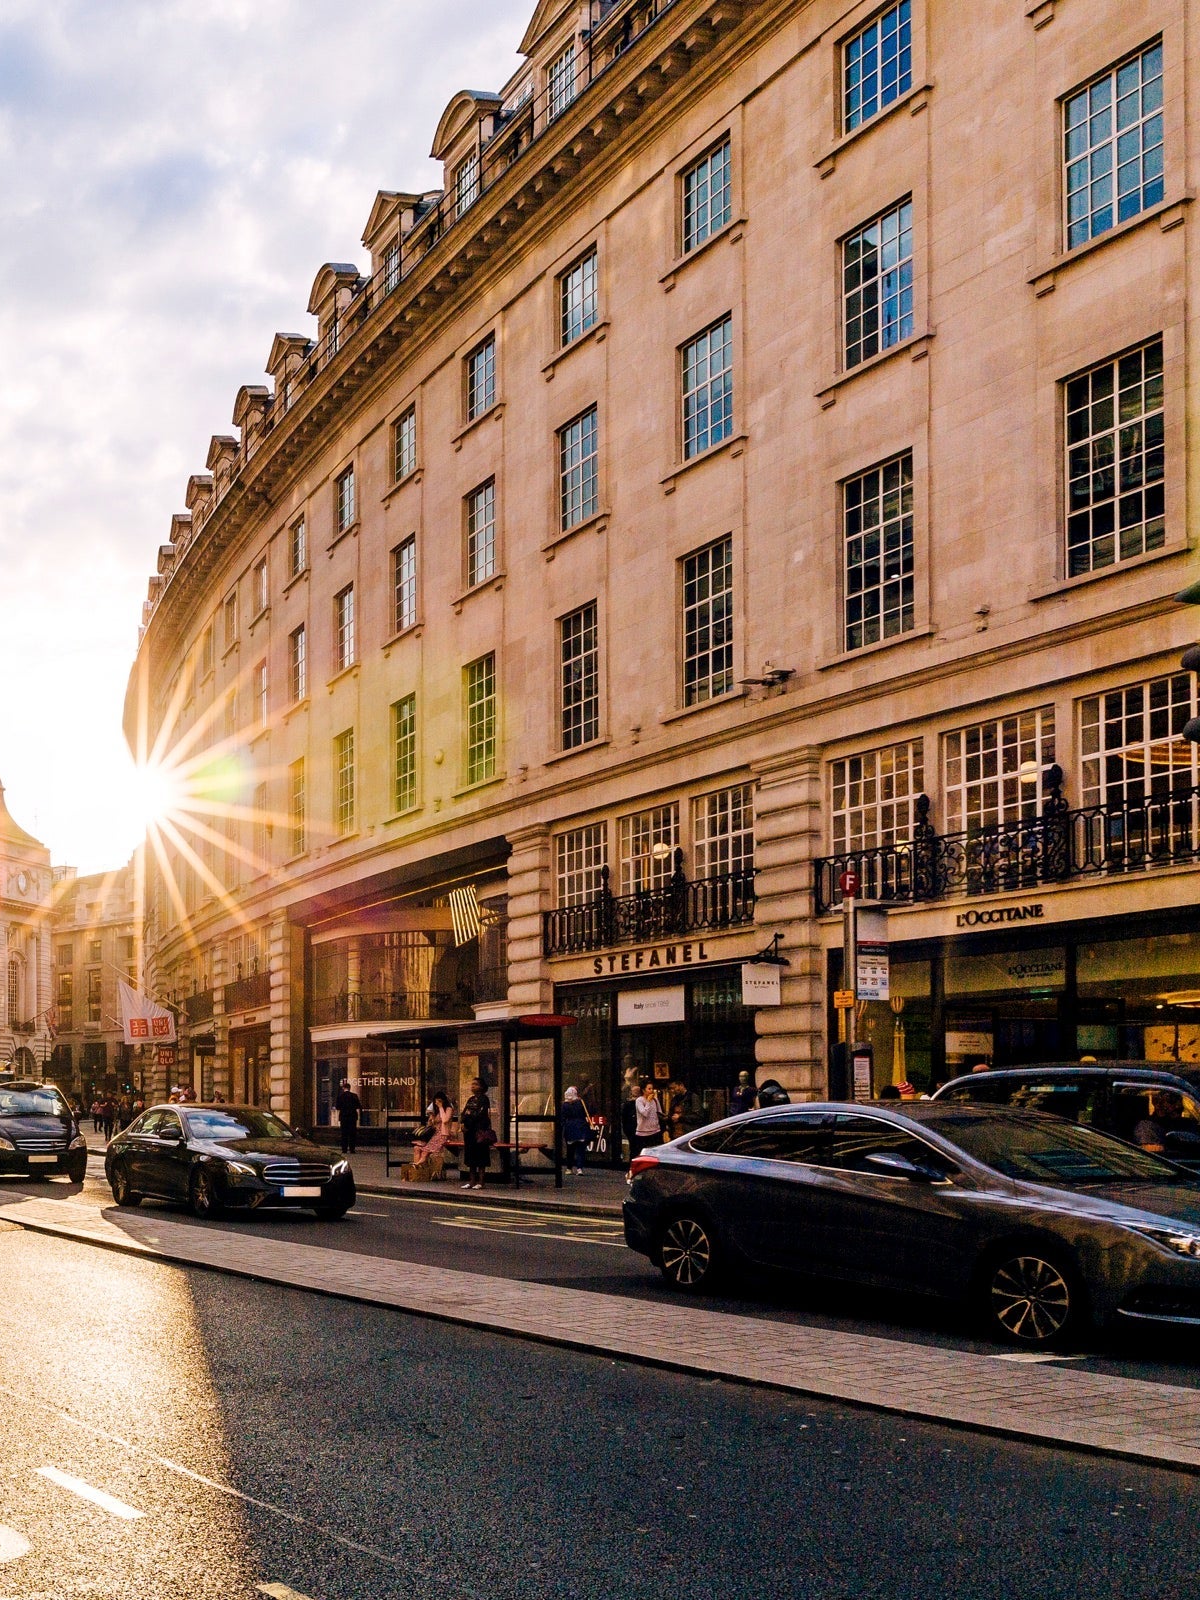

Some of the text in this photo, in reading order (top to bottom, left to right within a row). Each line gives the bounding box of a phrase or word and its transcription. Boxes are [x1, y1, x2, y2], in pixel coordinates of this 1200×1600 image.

[846, 875, 855, 890] F
[956, 904, 1044, 927] L'OCCITANE
[593, 942, 708, 974] STEFANEL
[160, 1050, 173, 1058] UNI
[160, 1057, 174, 1065] QLO
